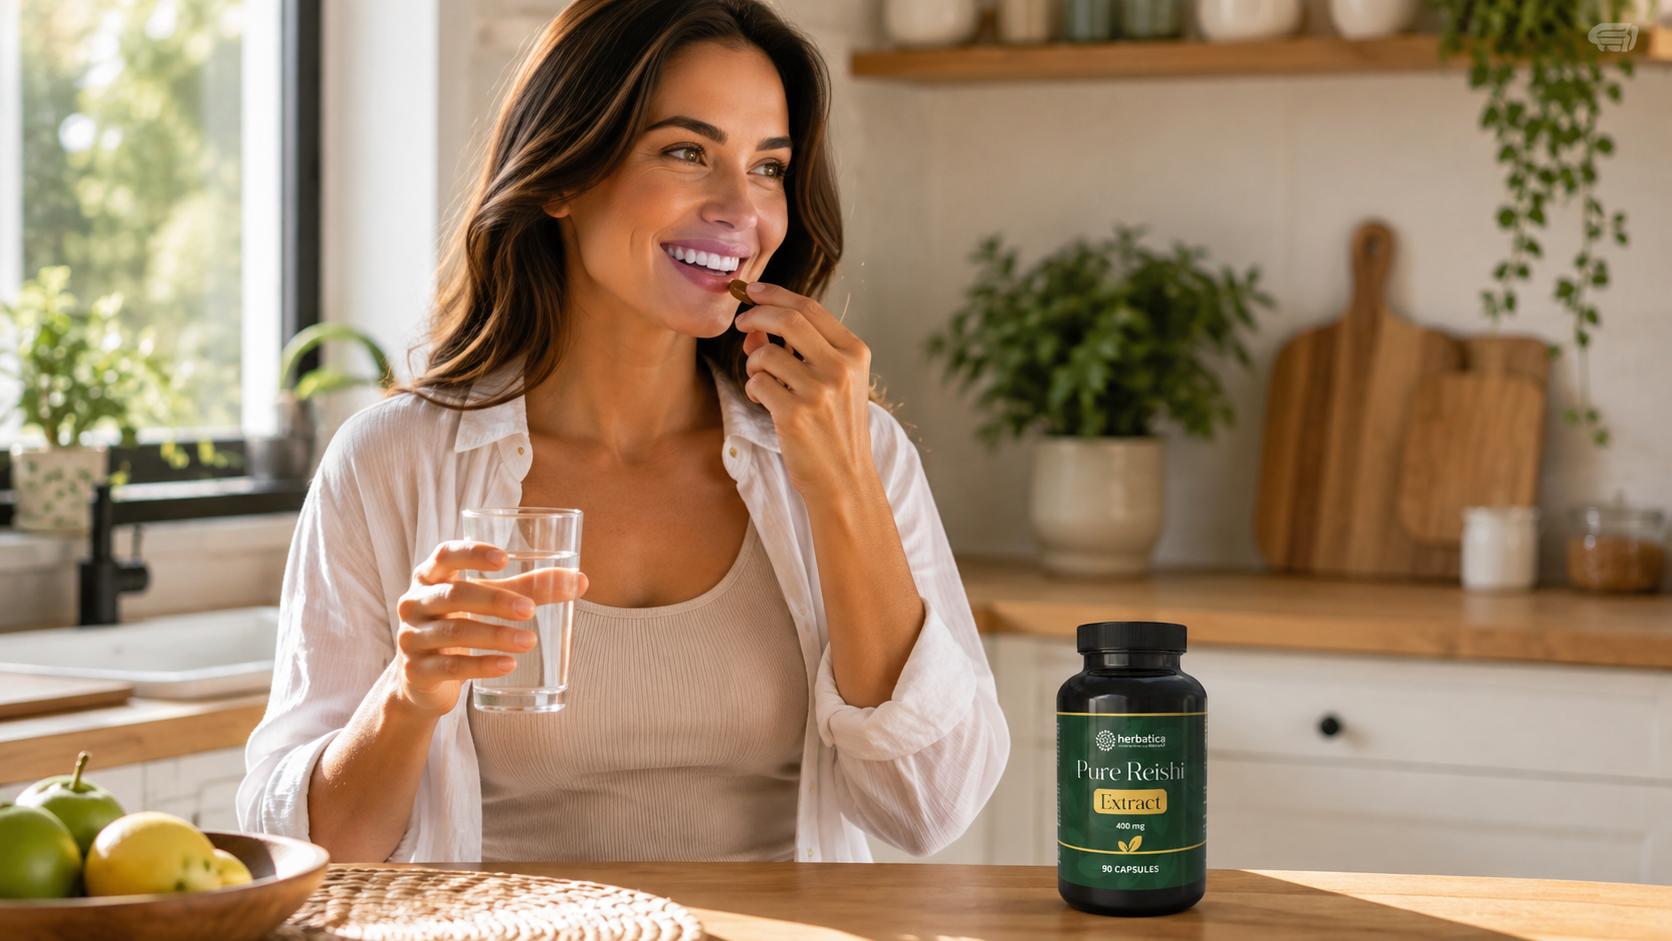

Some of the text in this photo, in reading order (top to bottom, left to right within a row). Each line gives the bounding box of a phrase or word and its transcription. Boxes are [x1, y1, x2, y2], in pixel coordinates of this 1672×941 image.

[1117, 734, 1166, 744] herbatica
[1077, 760, 1185, 781] Pure Reishi
[1101, 793, 1161, 810] Extract
[1116, 822, 1145, 831] 400 mg
[1102, 865, 1159, 873] 90 CAPSULES
